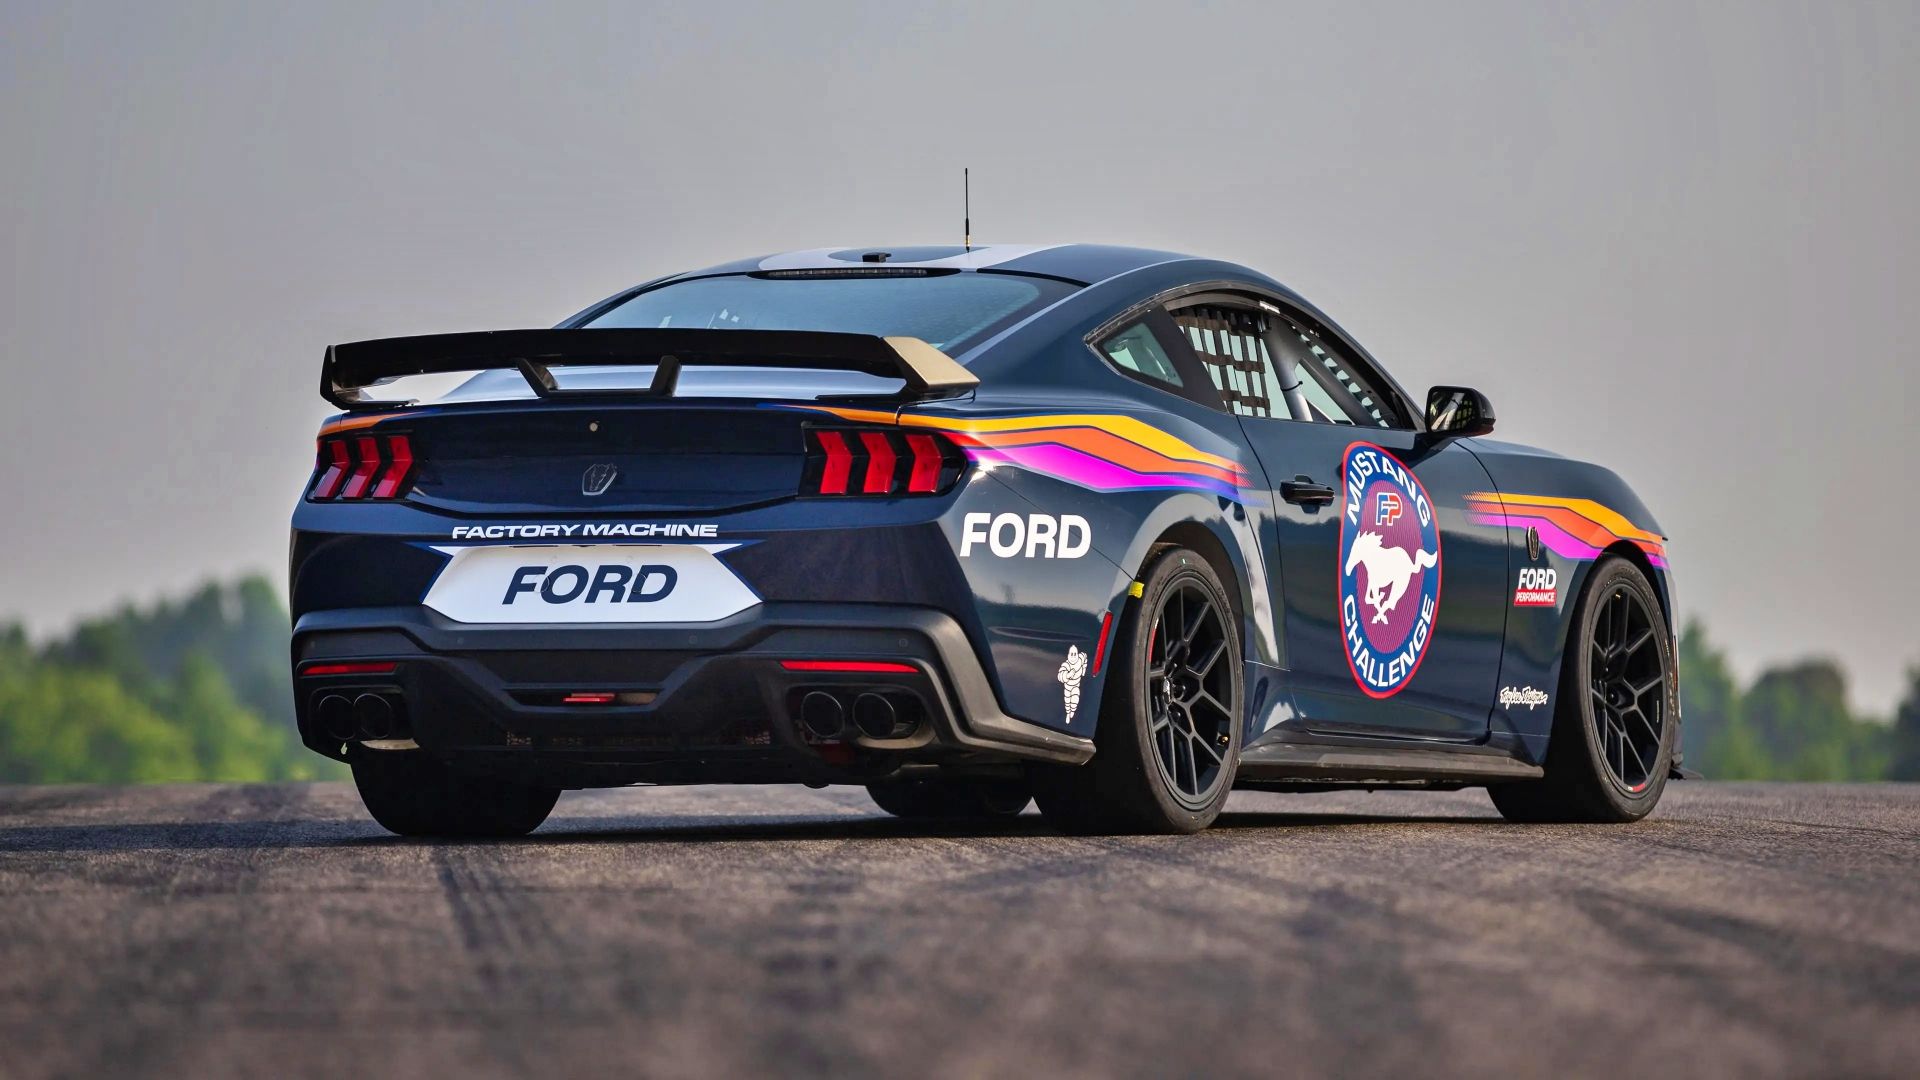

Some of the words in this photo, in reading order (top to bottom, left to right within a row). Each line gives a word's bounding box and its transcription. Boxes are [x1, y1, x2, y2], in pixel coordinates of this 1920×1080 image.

[1346, 450, 1431, 528] MUSTANG
[452, 524, 580, 539] FACTORY
[582, 523, 719, 538] MACHINE
[959, 512, 1092, 559] FORD
[501, 564, 678, 605] FORD
[1515, 591, 1556, 603] PERFORMANCE
[1517, 568, 1557, 590] FORD
[1343, 593, 1435, 688] CHALLENGE
